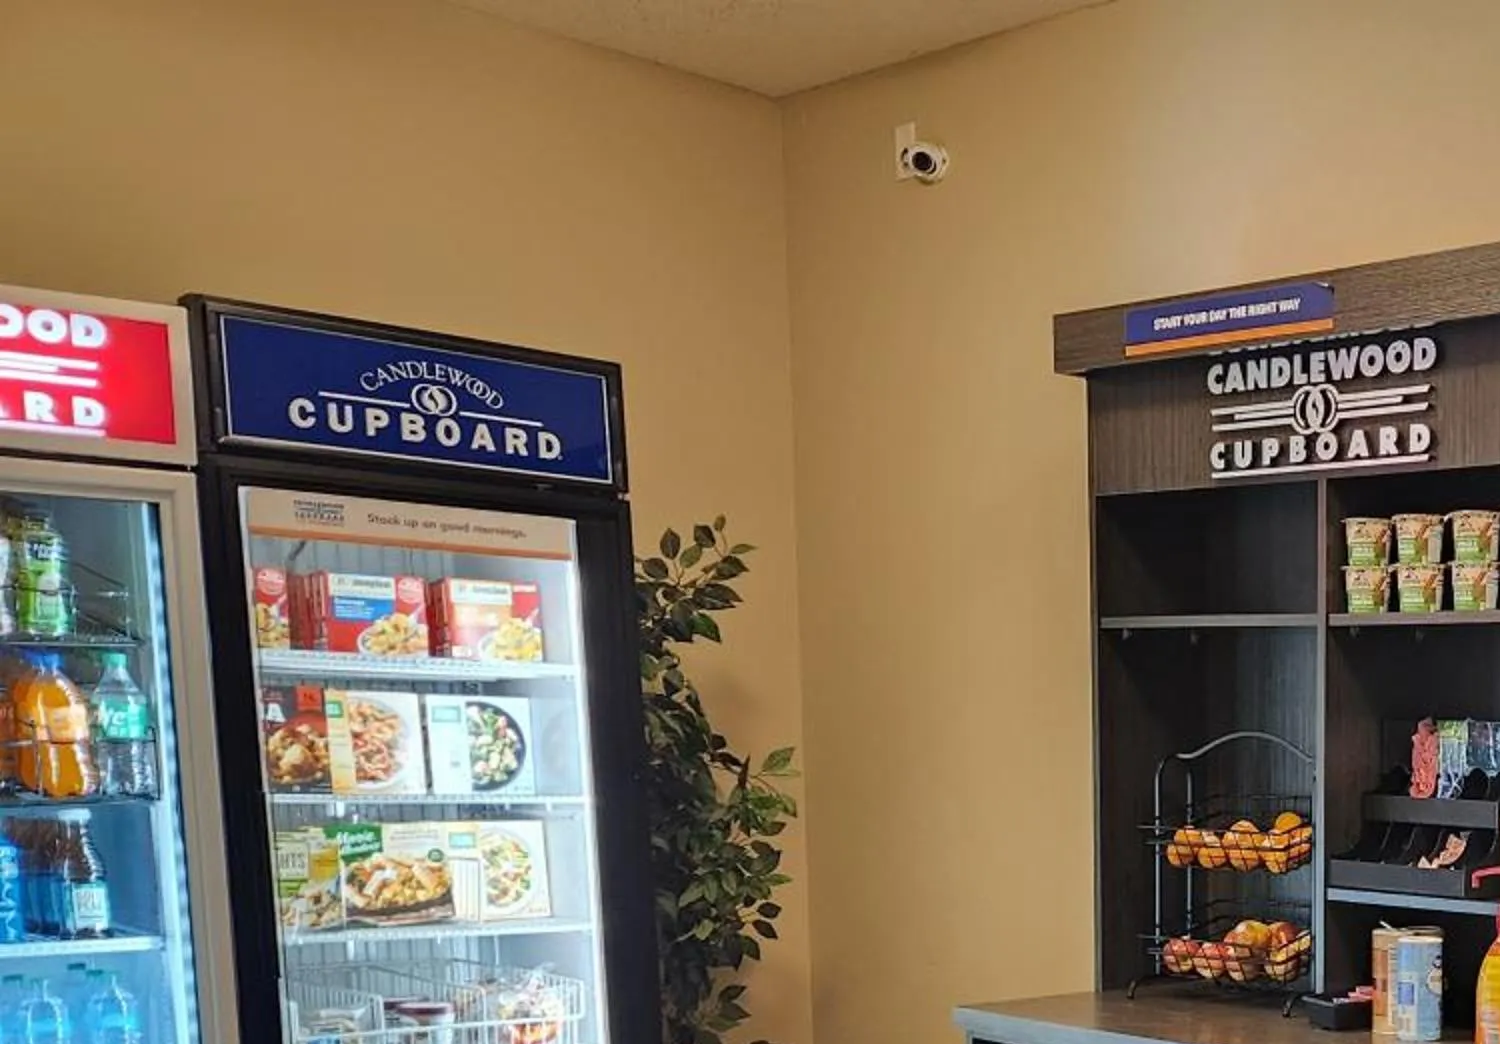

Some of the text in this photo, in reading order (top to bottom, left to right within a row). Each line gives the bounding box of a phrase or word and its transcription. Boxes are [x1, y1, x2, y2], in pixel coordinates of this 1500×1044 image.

[1153, 298, 1301, 331] START YOUR DAY THE RIGHT WAY
[360, 361, 504, 410] CANDLEWOOD
[1207, 337, 1437, 395] CANDLEWOOD
[288, 397, 562, 462] CUPBOARD
[1210, 423, 1431, 470] CUPBOARD
[367, 512, 400, 526] Stock
[403, 518, 418, 529] up
